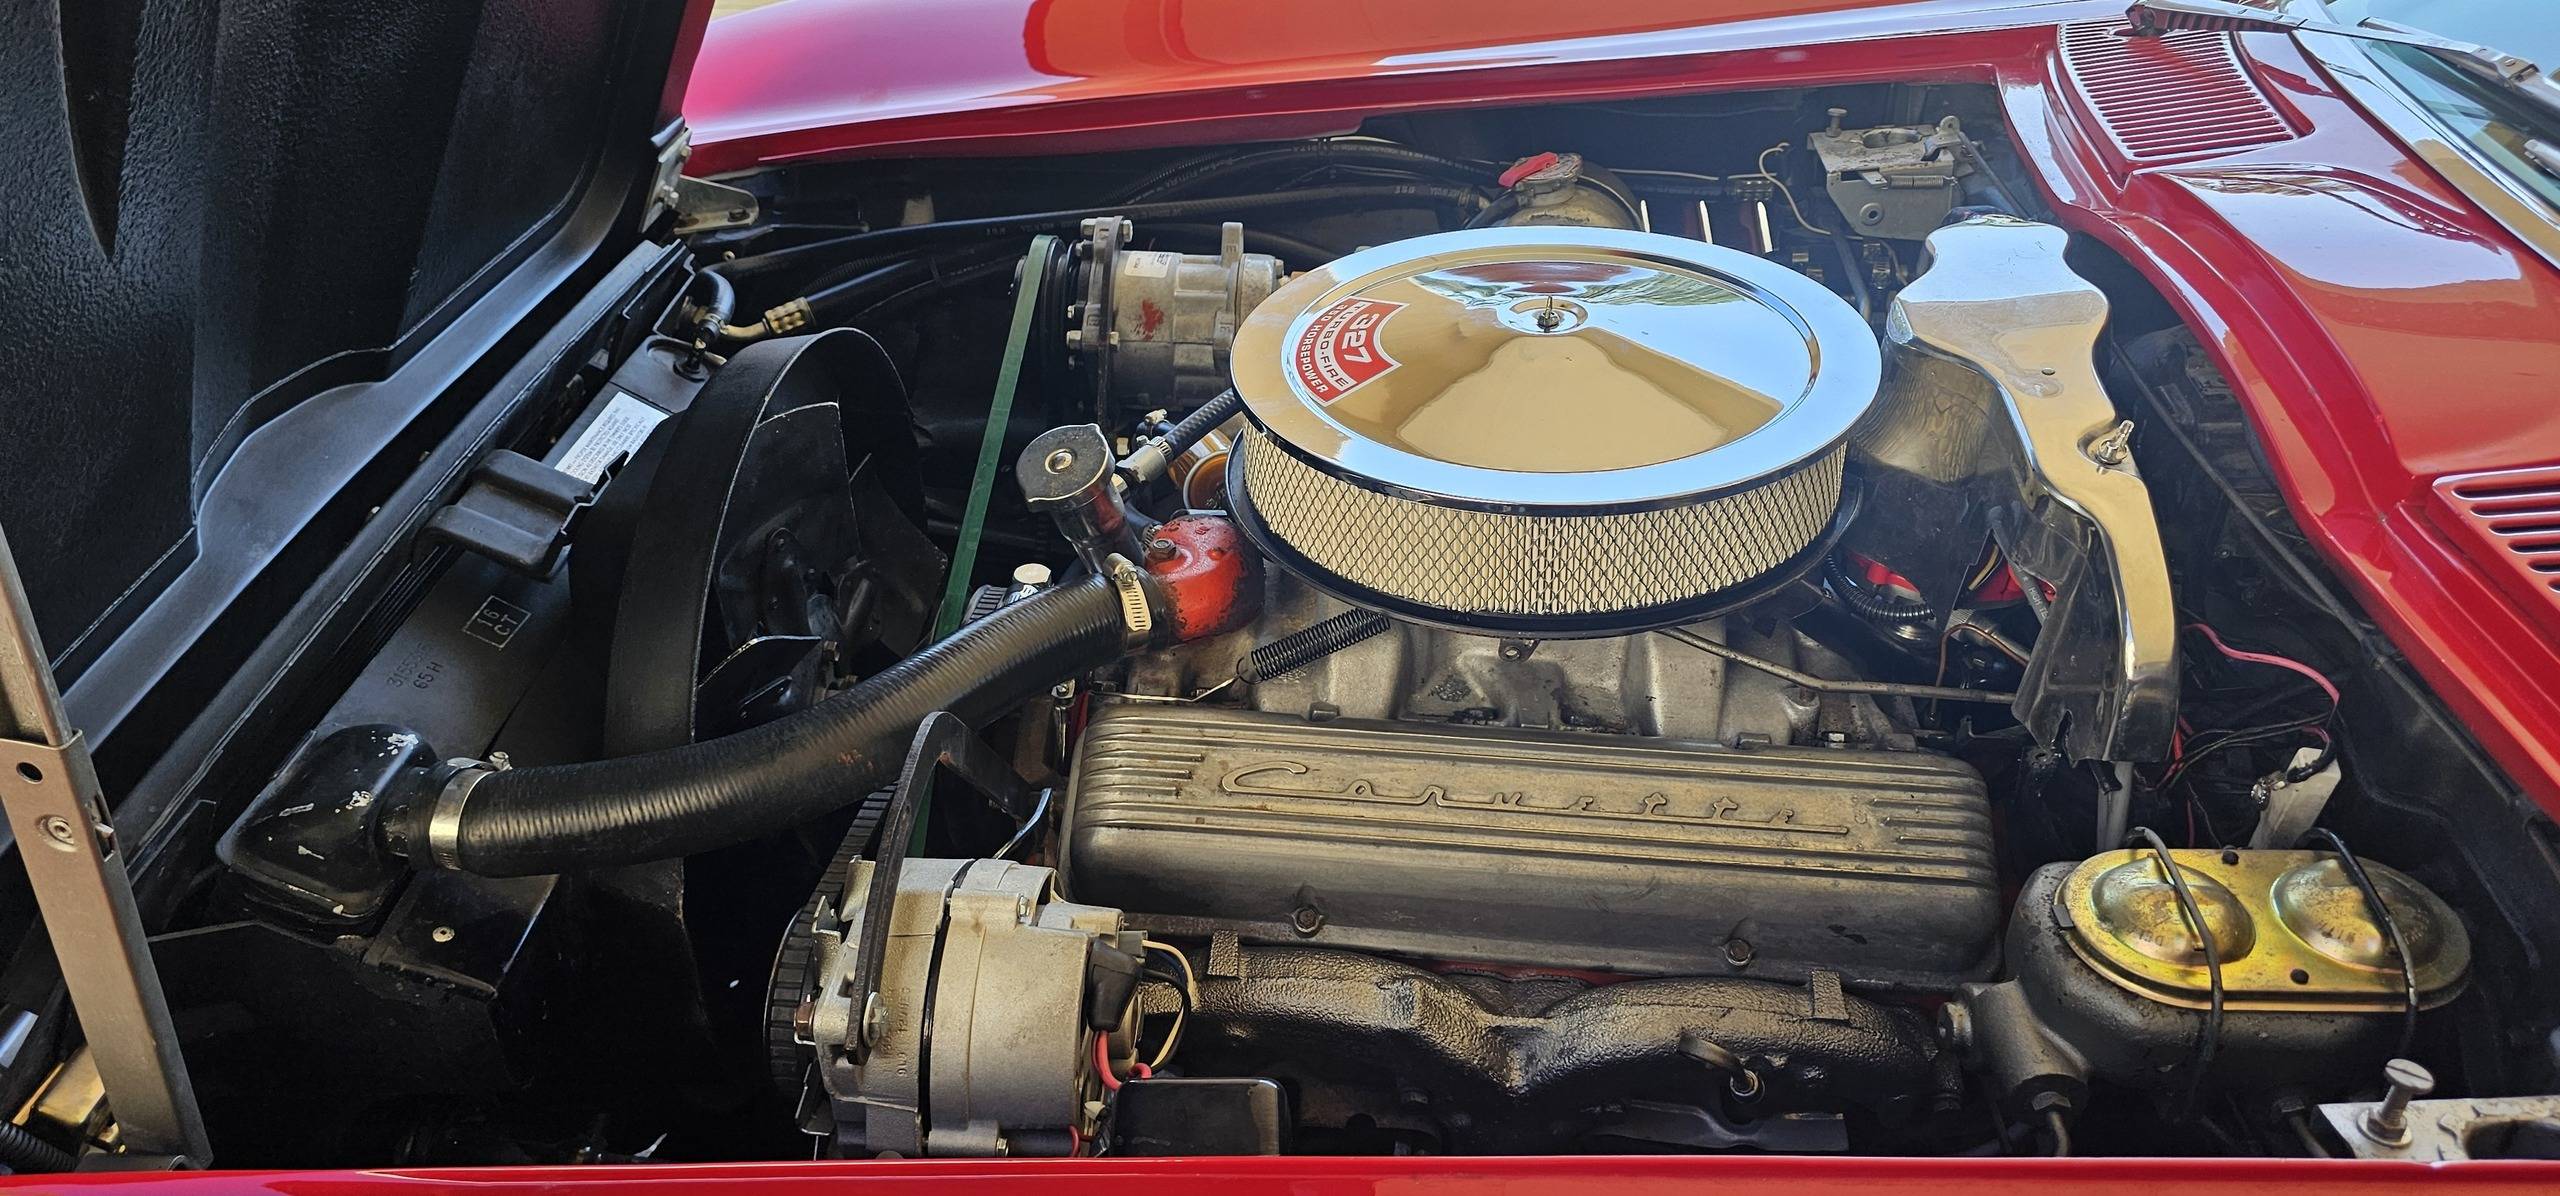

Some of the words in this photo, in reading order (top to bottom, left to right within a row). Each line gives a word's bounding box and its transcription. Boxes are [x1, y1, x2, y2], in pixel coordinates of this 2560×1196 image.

[1341, 313, 1380, 363] 327
[1300, 324, 1329, 393] HORSEPOWER
[476, 608, 500, 627] 16
[494, 613, 519, 636] CT
